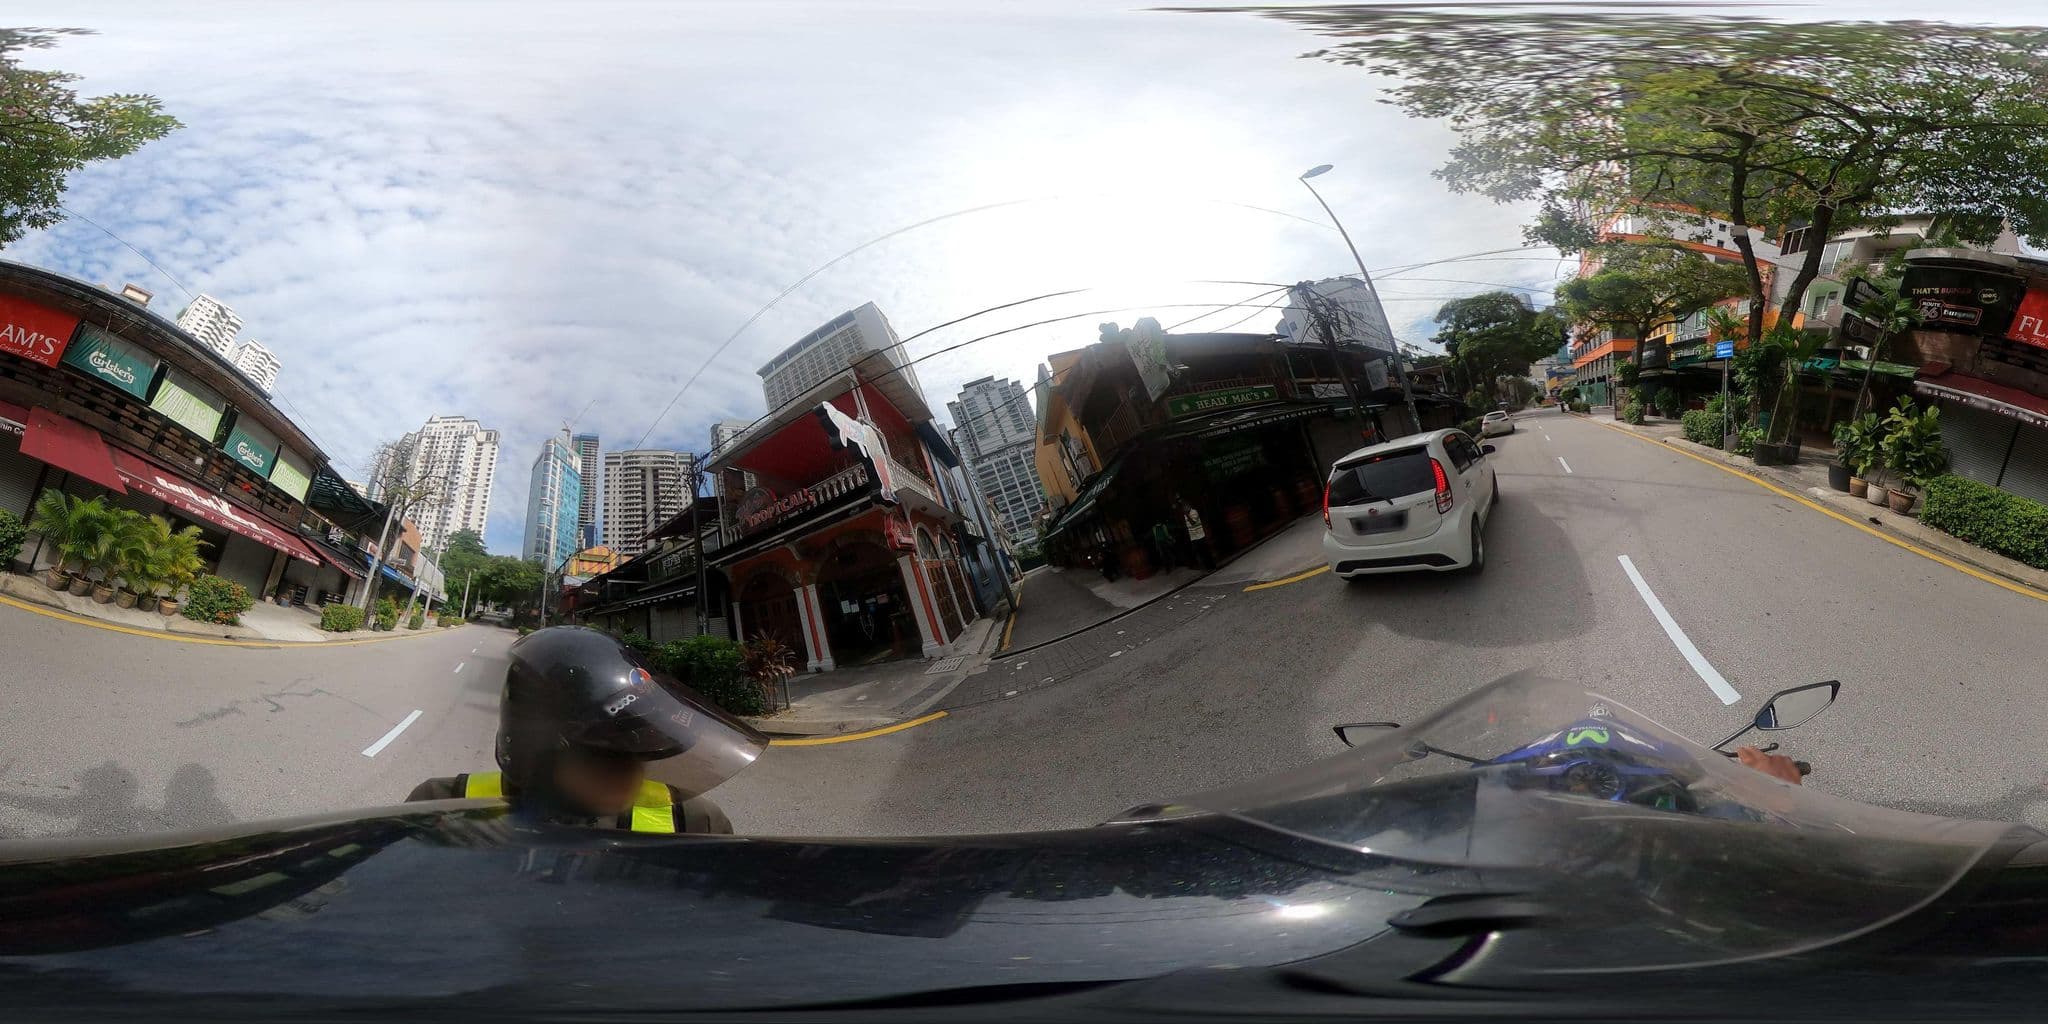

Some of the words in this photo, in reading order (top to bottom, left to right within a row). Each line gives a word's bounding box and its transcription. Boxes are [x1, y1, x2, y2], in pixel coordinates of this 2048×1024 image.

[2018, 315, 2048, 338] FL
[89, 351, 135, 384] Carlsberg
[1195, 396, 1228, 410] HEALY
[1232, 391, 1260, 404] MAC'S
